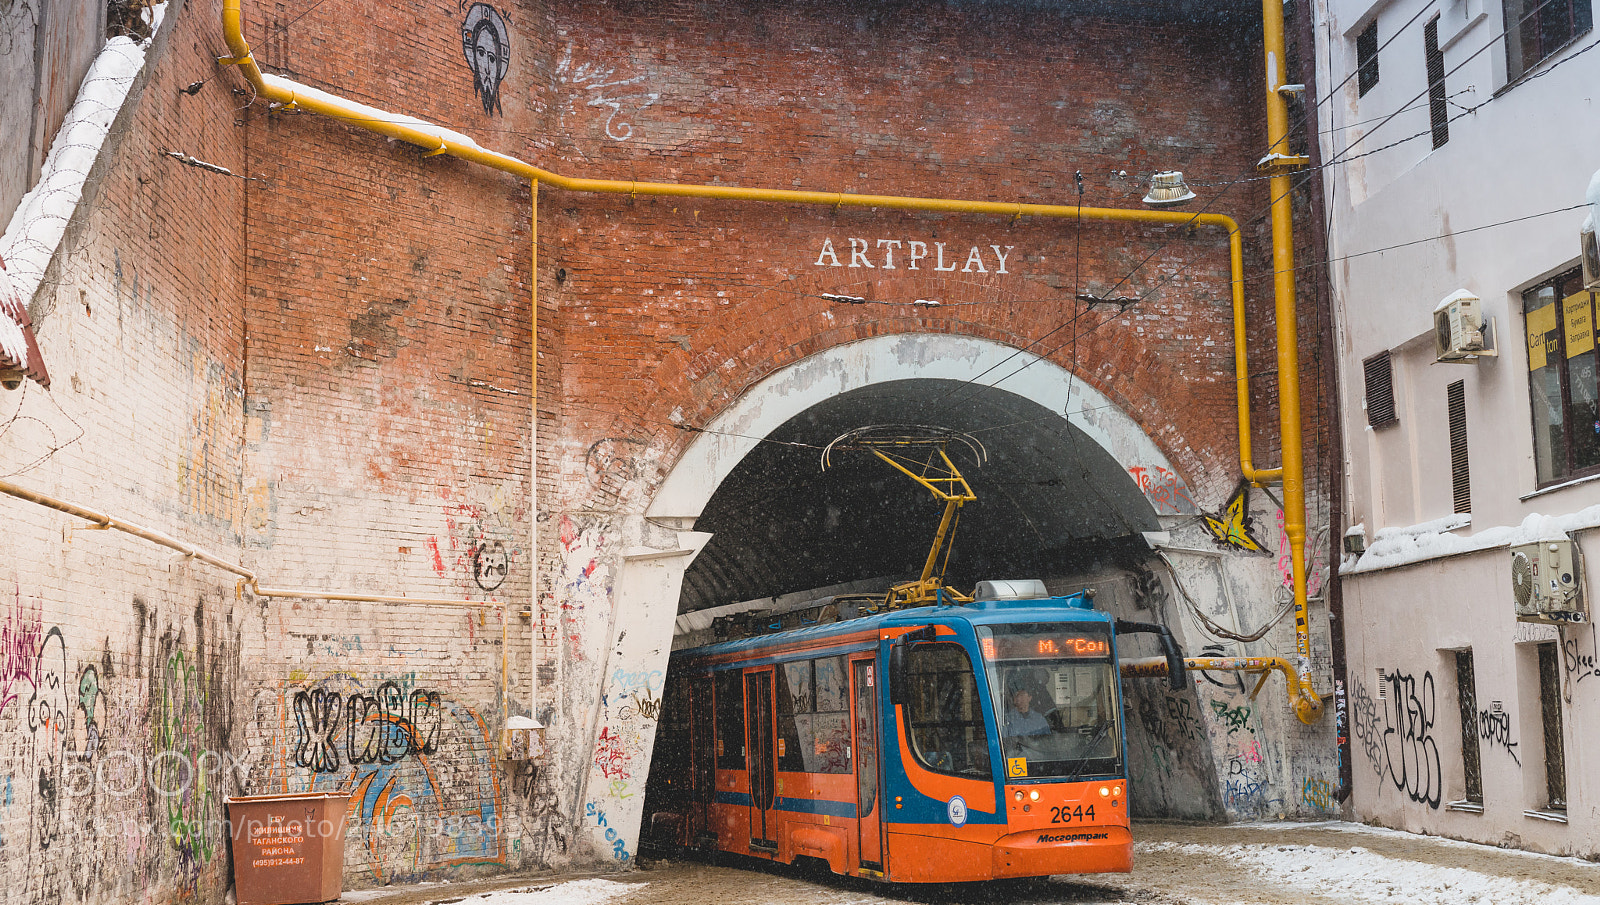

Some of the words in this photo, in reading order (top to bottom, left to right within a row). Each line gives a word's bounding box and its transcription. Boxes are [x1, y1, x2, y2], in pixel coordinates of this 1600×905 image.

[814, 236, 1015, 274] ARTPLAY
[1565, 299, 1590, 315] Картриджи
[1570, 315, 1587, 329] Бумага
[1529, 330, 1546, 349] Cart
[1546, 338, 1558, 353] ton
[1569, 329, 1590, 343] Заправка
[270, 815, 286, 823] ГБУ
[1050, 804, 1096, 824] 2644
[252, 836, 304, 845] ТАГАНСКОГО
[1036, 832, 1109, 844] Мосгортранс
[261, 847, 295, 856] РАЙОНА
[252, 857, 304, 868] (495)912-44-87
